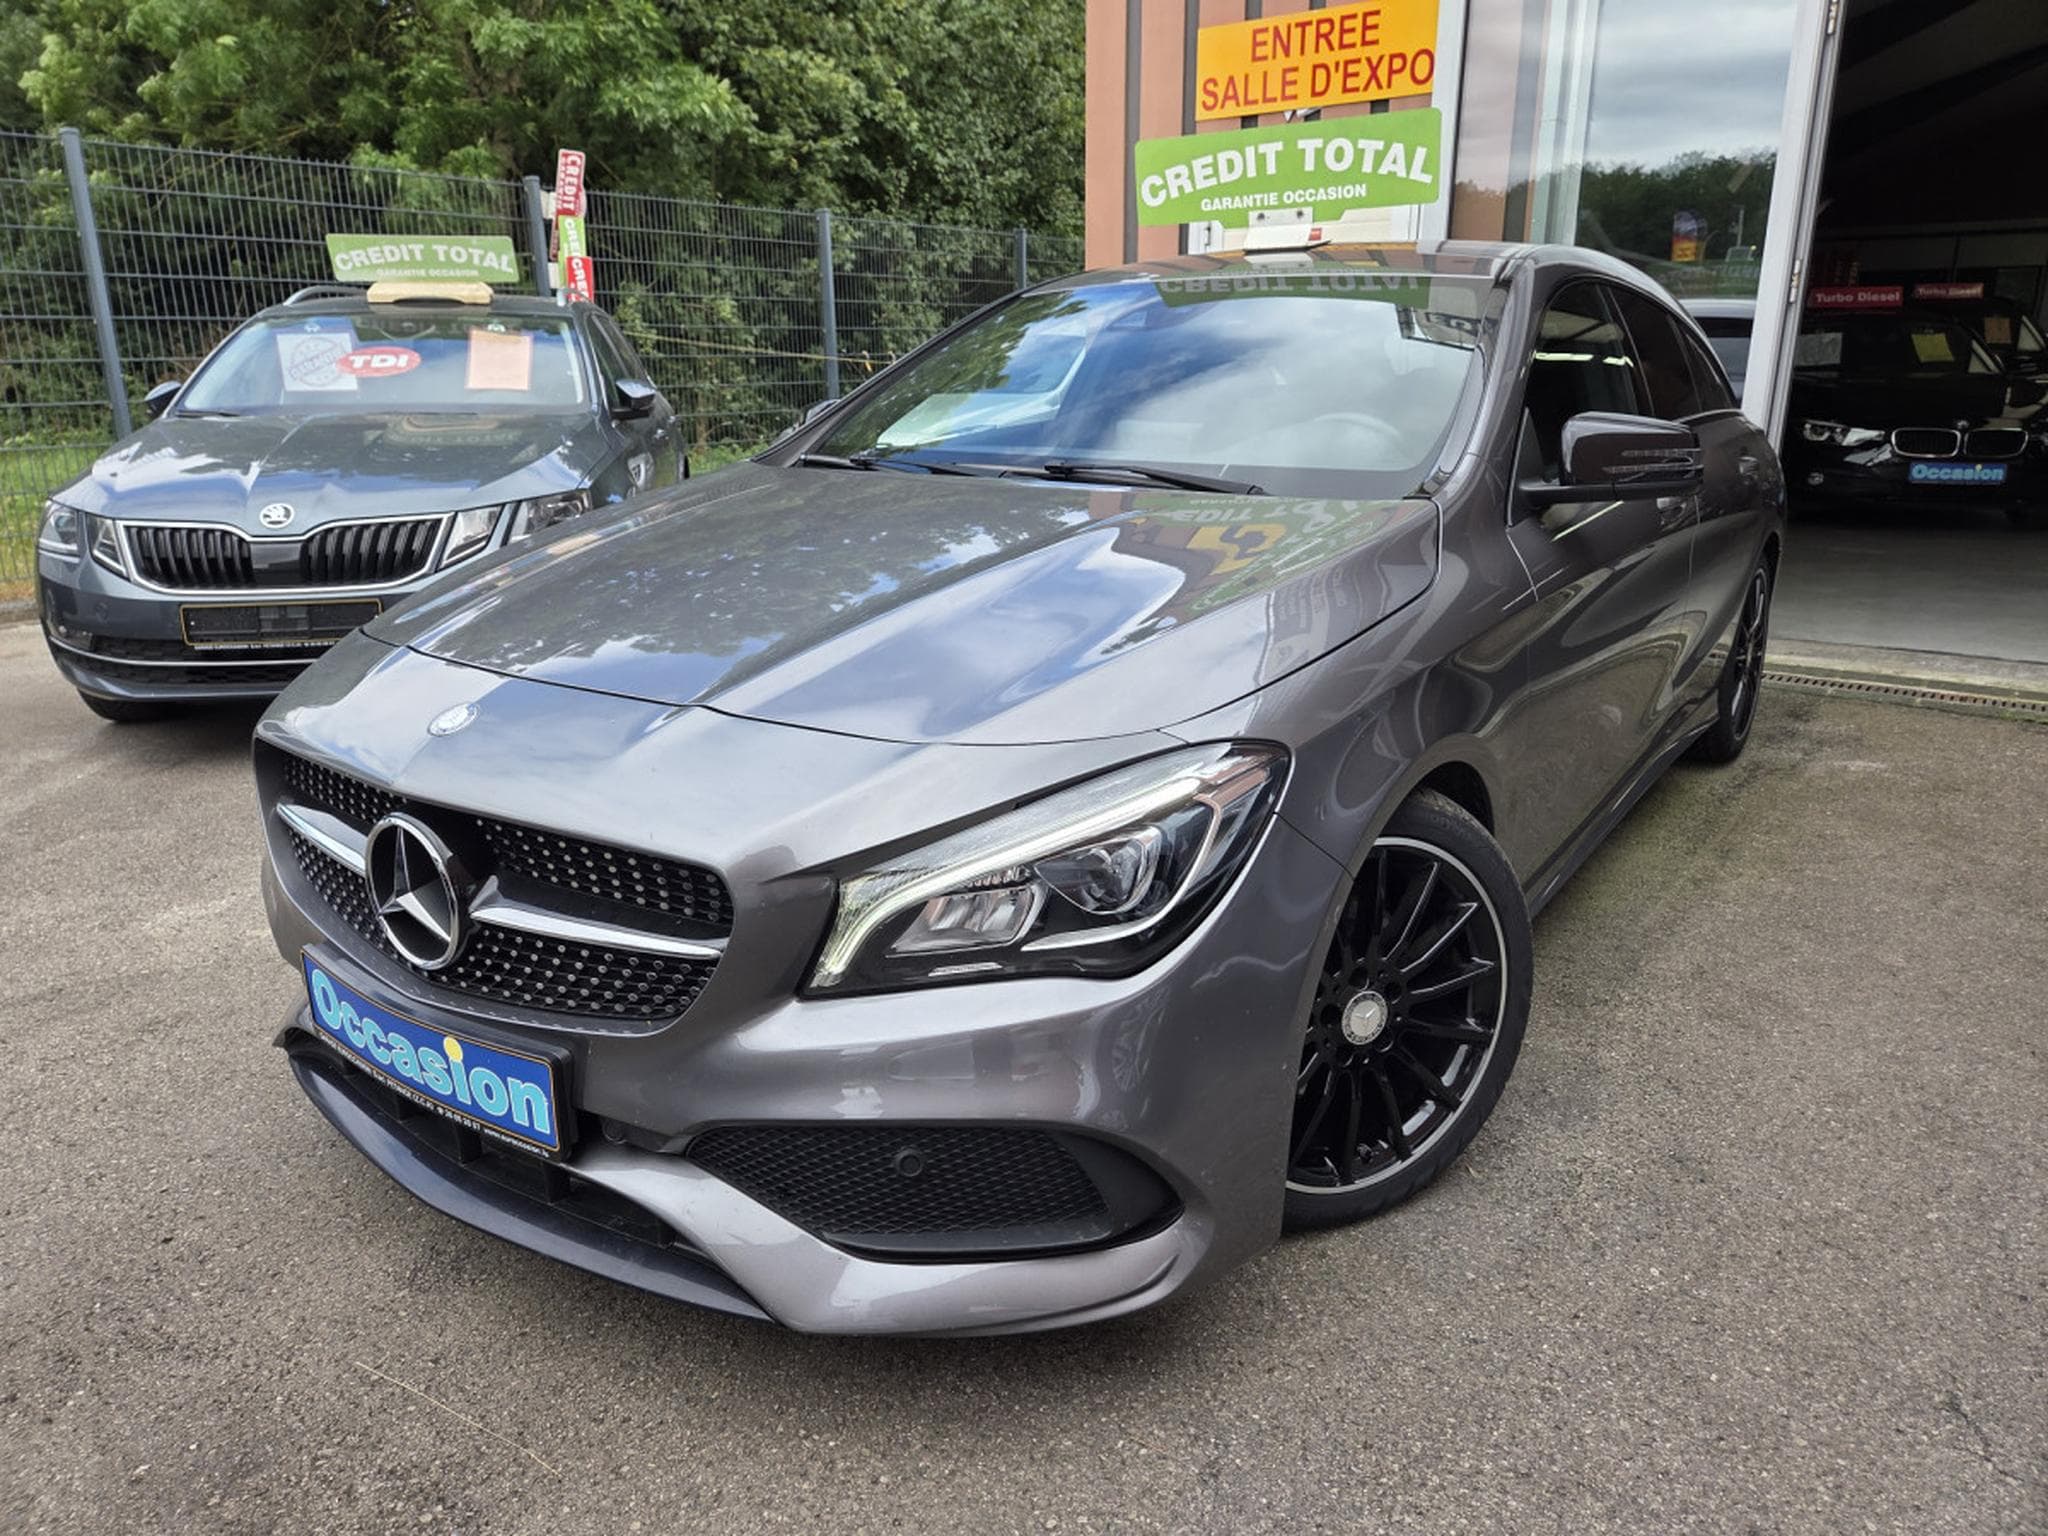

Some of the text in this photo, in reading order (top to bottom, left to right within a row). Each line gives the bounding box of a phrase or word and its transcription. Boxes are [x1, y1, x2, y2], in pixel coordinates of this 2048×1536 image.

[1251, 10, 1381, 62] ENTREE
[1202, 49, 1434, 111] SALLE D'EXPO
[563, 154, 582, 210] CREDIT
[1141, 138, 1433, 207] CREDIT TOTAL
[1201, 184, 1366, 211] GARANTIE OCCASION
[335, 244, 514, 273] CREDIT TOTAL
[1816, 290, 1900, 303] Turbo Diesel
[349, 354, 409, 369] TDI
[1911, 463, 2005, 481] Occasion
[312, 968, 550, 1135] Occasion
